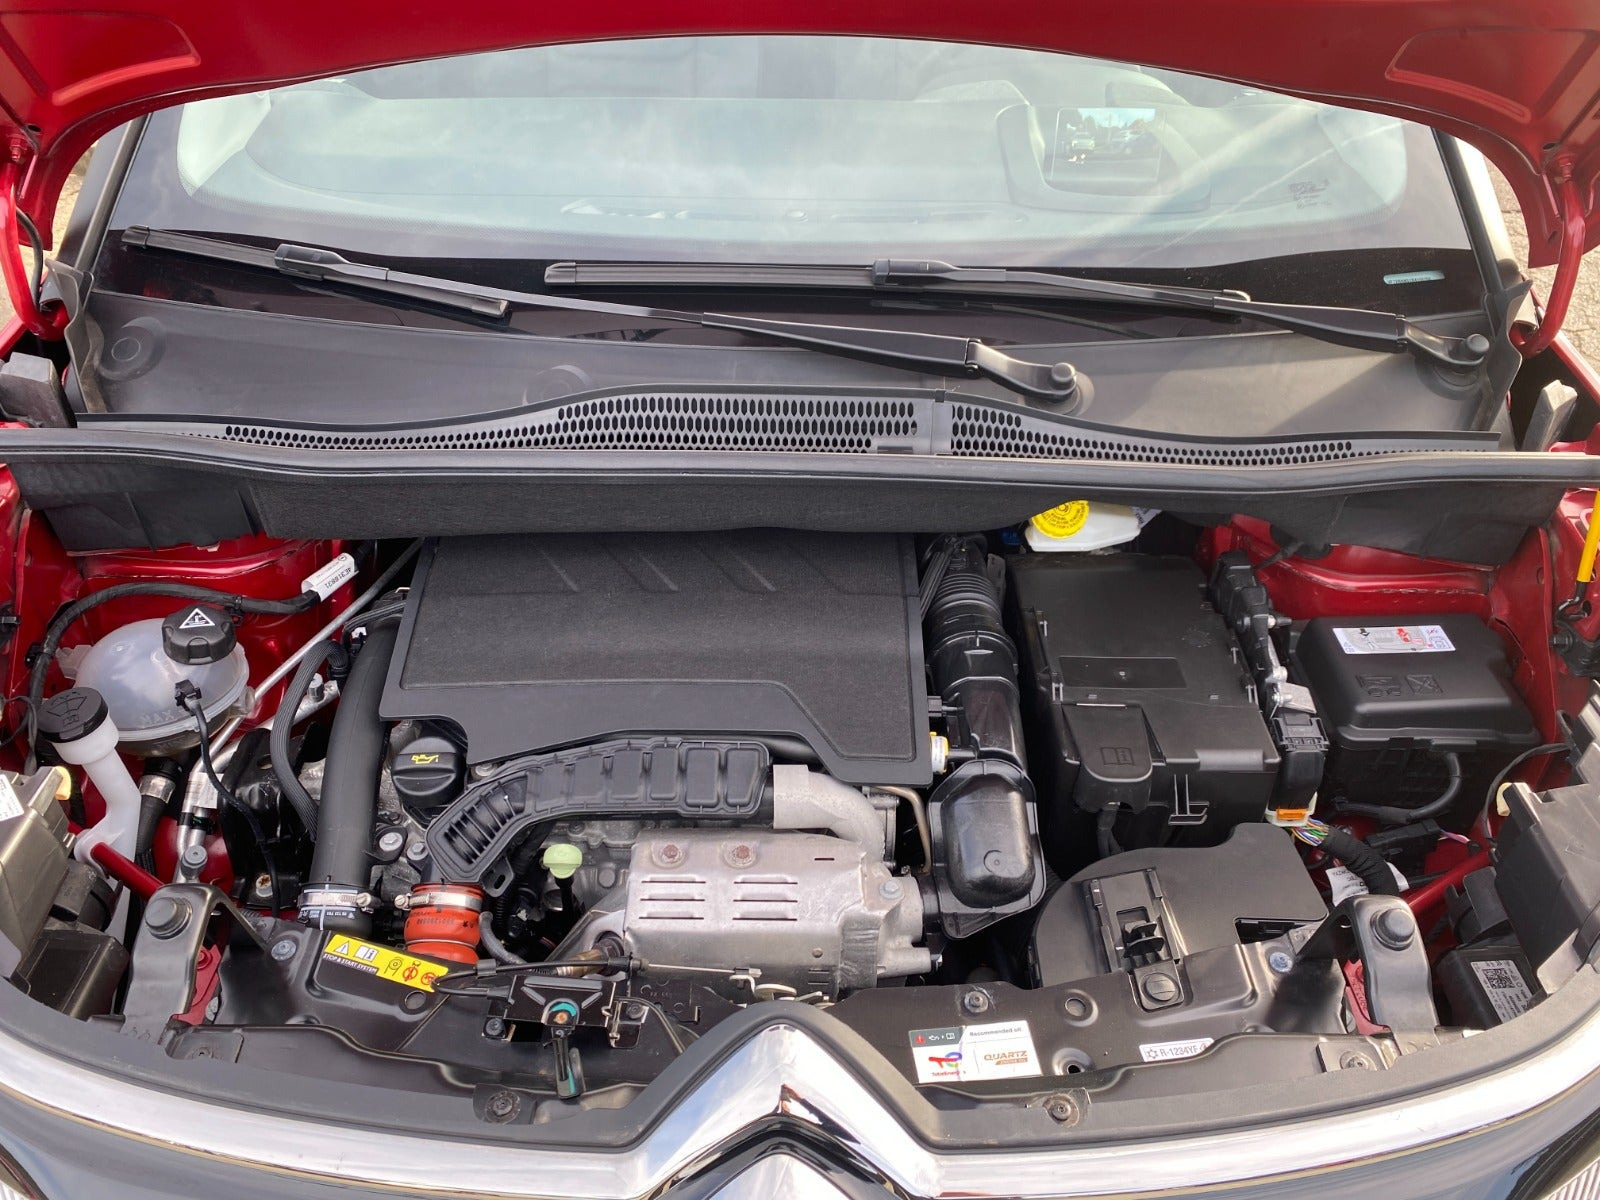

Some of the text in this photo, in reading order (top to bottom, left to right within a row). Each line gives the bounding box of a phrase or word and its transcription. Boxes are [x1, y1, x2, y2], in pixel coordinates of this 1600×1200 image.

[323, 953, 338, 962] STOP
[341, 958, 357, 968] START
[357, 964, 378, 974] SYSTEM
[970, 1028, 1013, 1037] Recommended
[984, 1050, 1028, 1061] QUARTZ
[1159, 1045, 1199, 1057] R-1234YF
